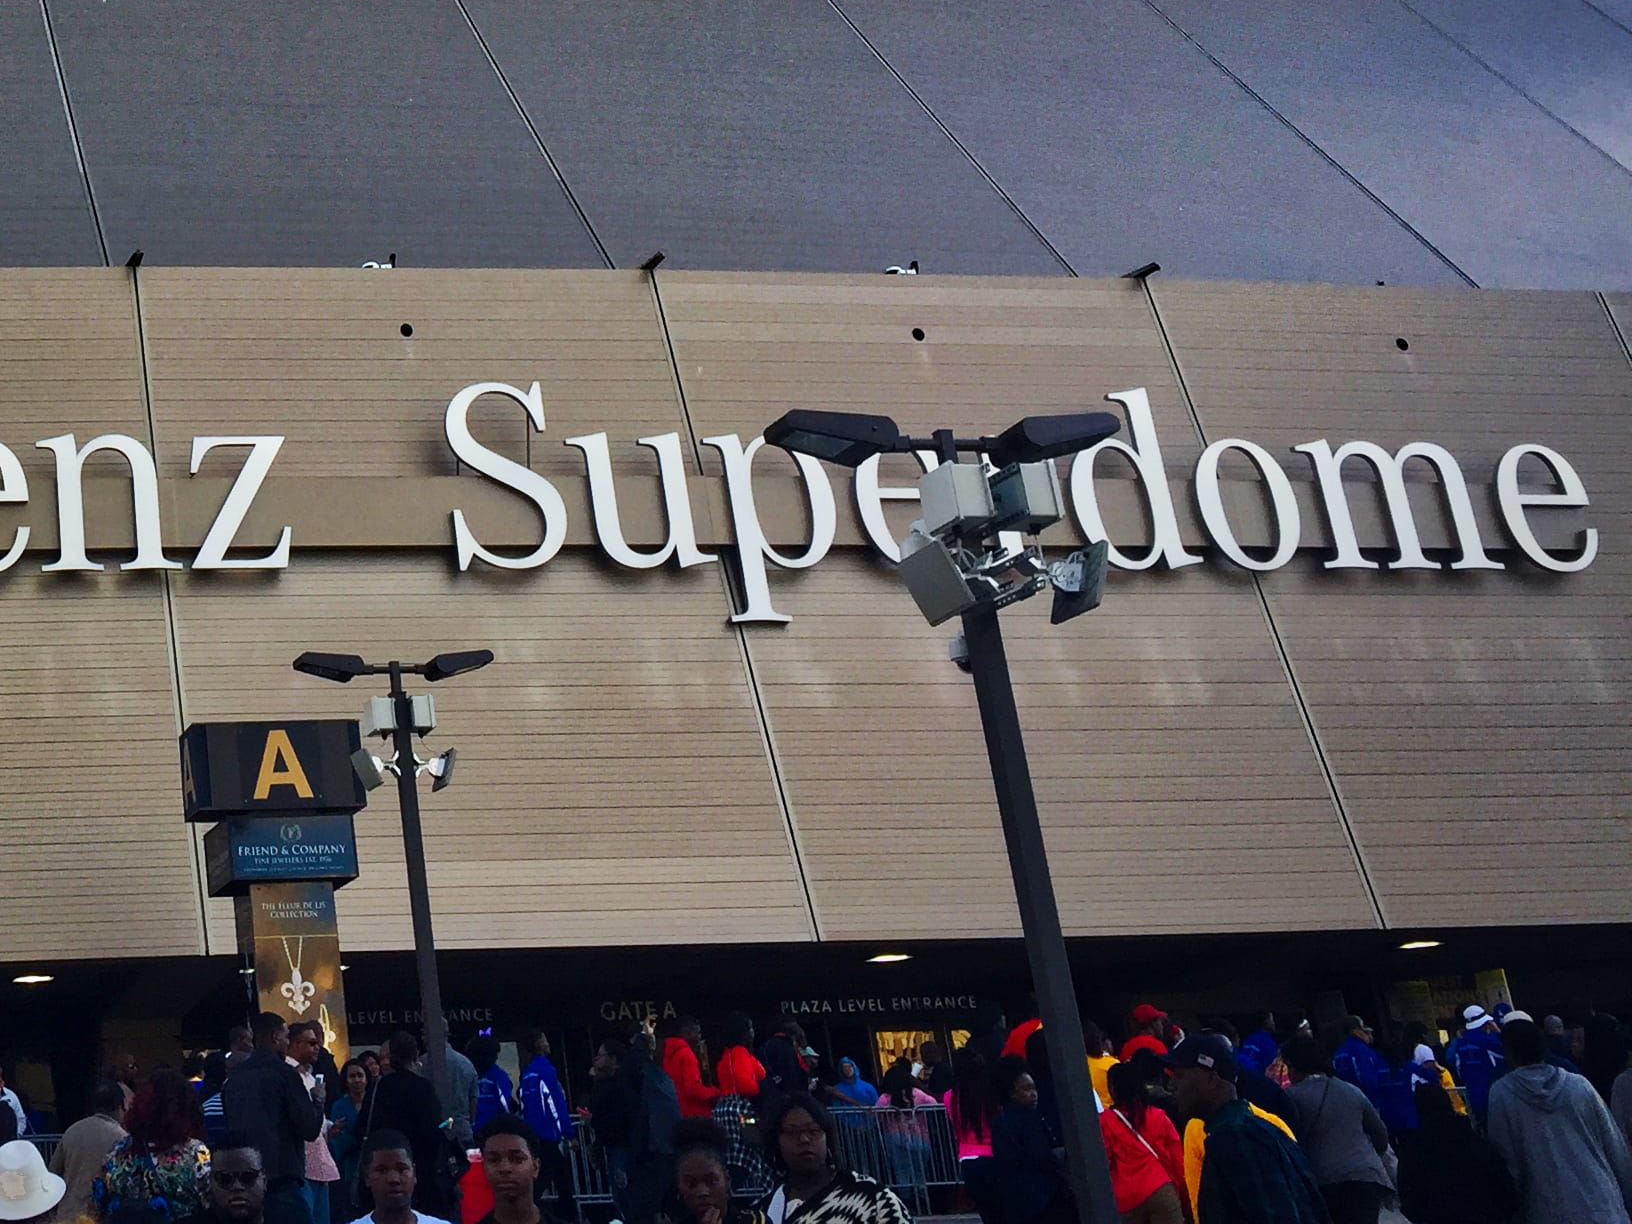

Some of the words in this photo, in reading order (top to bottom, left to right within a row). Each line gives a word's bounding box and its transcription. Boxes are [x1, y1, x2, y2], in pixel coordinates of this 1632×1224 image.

[443, 380, 1600, 623] Supedome
[253, 729, 314, 800] A
[237, 845, 278, 856] FRIEND
[281, 845, 289, 855] &
[291, 844, 346, 855] COMPANY
[270, 910, 319, 919] COLLECTION
[302, 901, 313, 909] DE
[600, 1000, 658, 1022] GATE
[663, 1000, 678, 1019] A
[780, 998, 832, 1015] PLAZA
[838, 997, 885, 1013] LEVEL
[891, 994, 977, 1011] ENTRANCE
[348, 1009, 396, 1026] LEVEL
[404, 1007, 494, 1024] ENANCE
